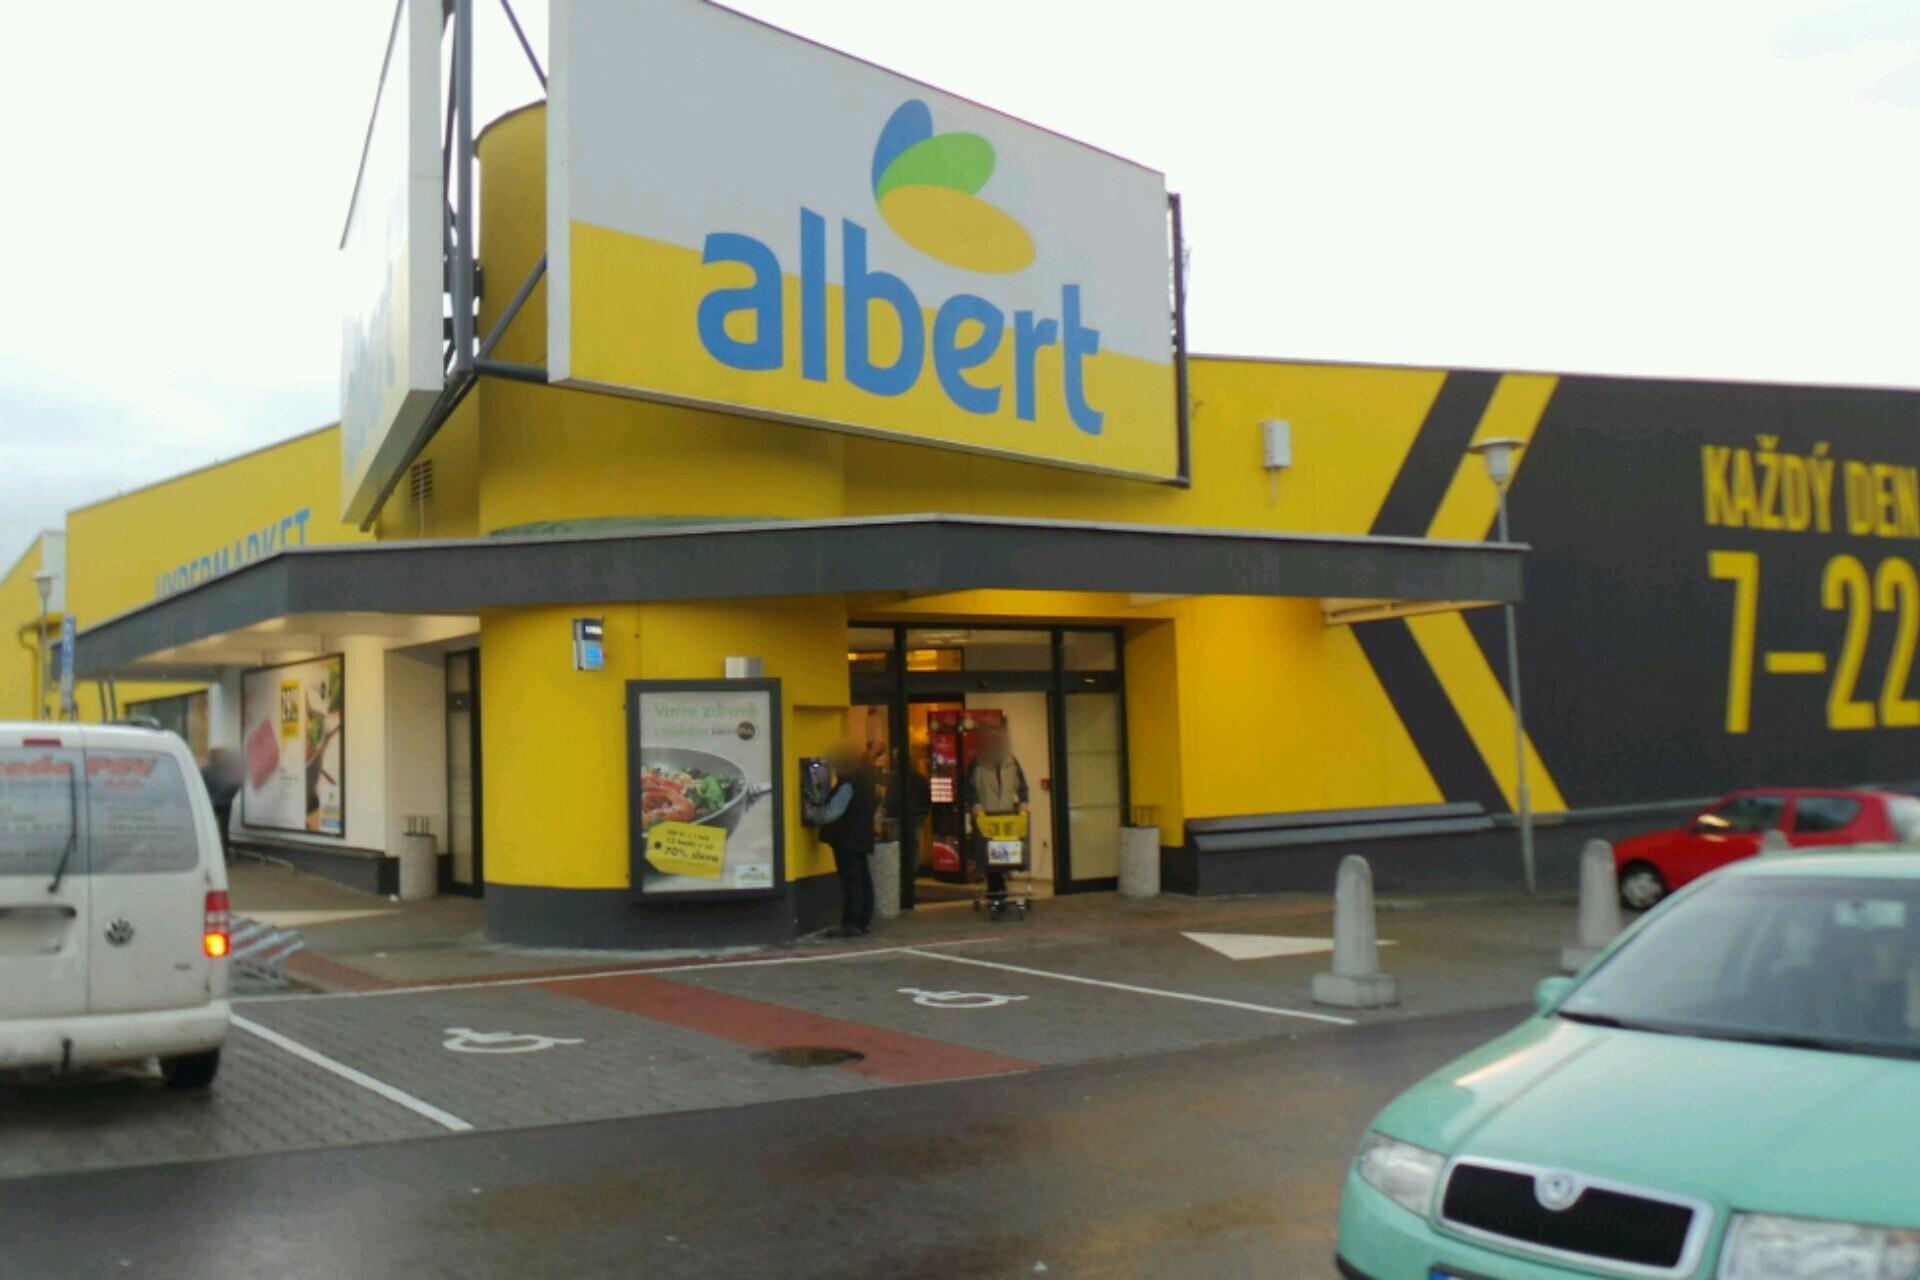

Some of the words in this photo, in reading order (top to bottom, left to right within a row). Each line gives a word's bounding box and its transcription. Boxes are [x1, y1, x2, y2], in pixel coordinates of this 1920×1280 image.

[697, 205, 1104, 436] albert
[1701, 433, 1836, 533] KAŽDÝ
[1843, 460, 1920, 540] DEN
